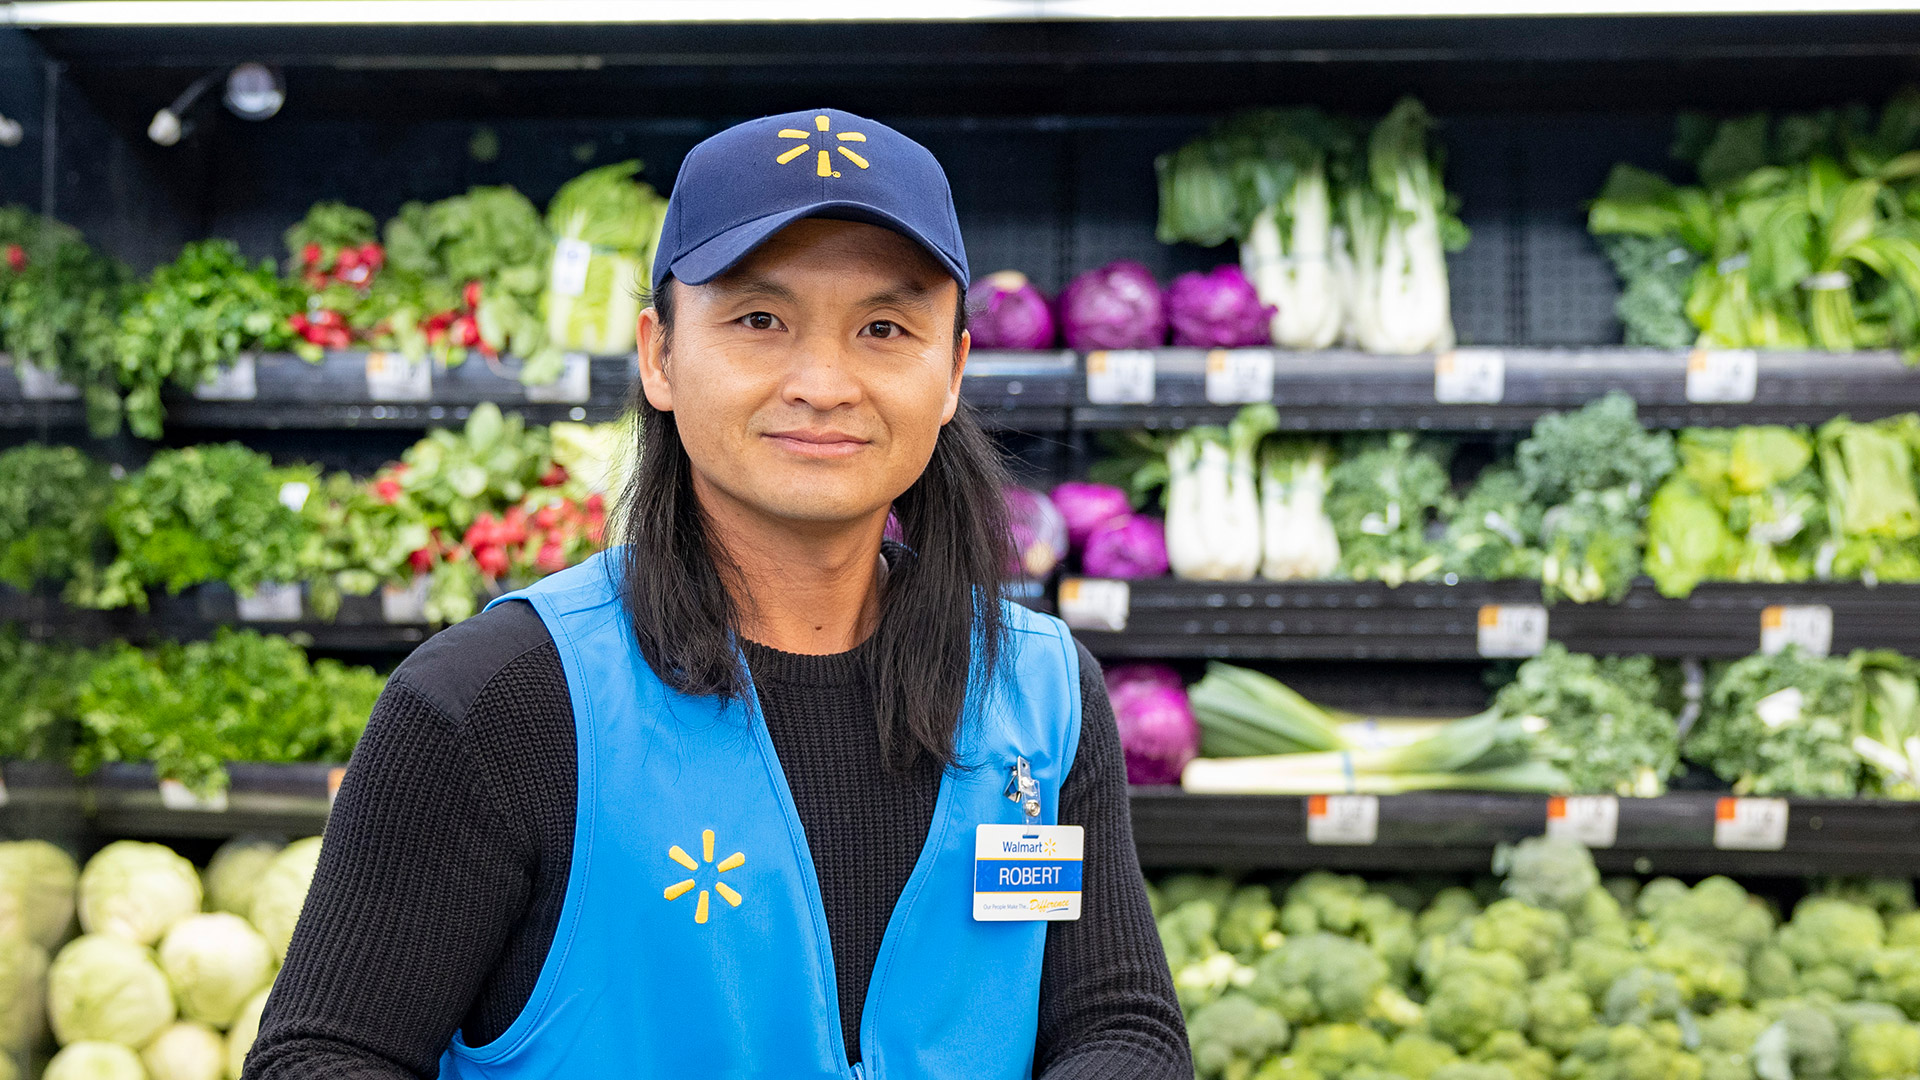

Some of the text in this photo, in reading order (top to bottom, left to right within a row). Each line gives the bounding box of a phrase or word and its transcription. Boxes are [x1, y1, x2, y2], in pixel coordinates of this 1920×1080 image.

[1002, 841, 1042, 853] Walmart
[999, 866, 1063, 886] ROBERT
[1029, 898, 1070, 913] Difference
